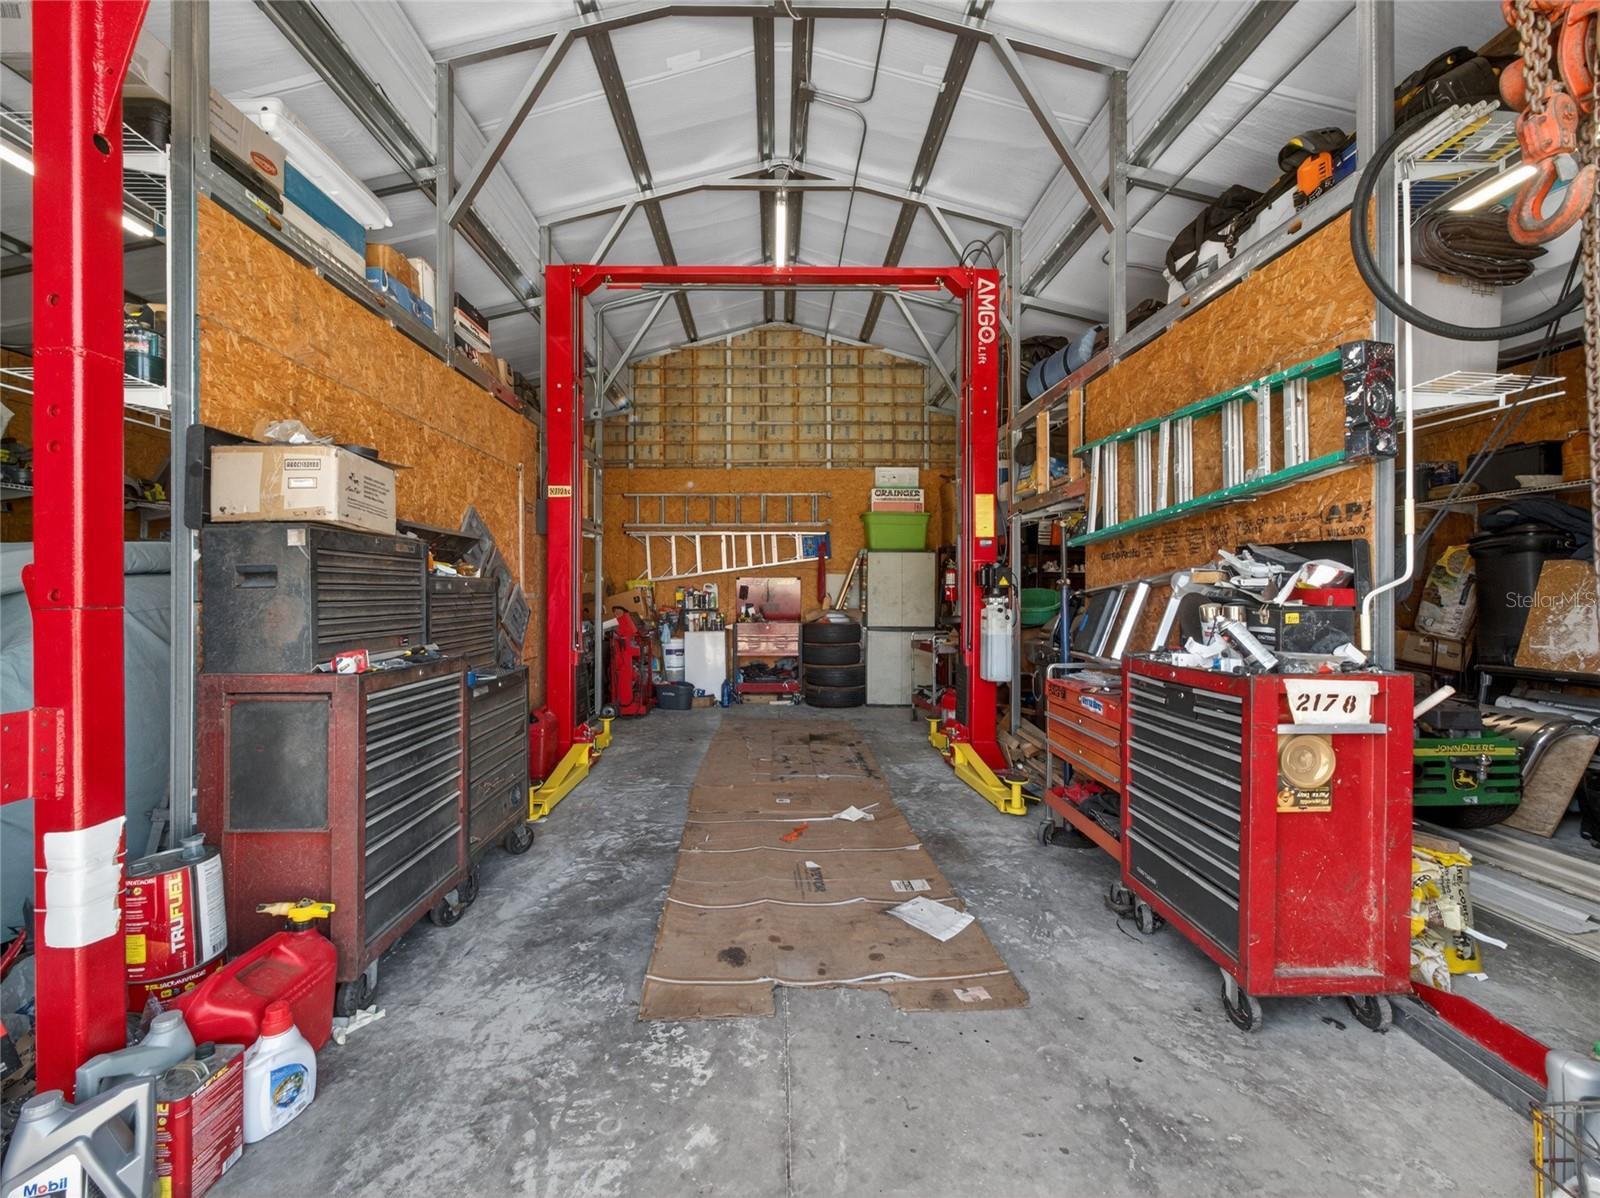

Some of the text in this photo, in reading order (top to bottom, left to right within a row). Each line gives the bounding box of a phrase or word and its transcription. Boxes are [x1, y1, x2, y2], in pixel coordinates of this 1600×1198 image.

[977, 277, 996, 344] AMGO
[874, 489, 921, 497] GRAINGER
[1434, 743, 1496, 754] JOHN DEERE
[168, 870, 186, 954] TRUFUEL
[23, 1177, 68, 1197] Mobil
